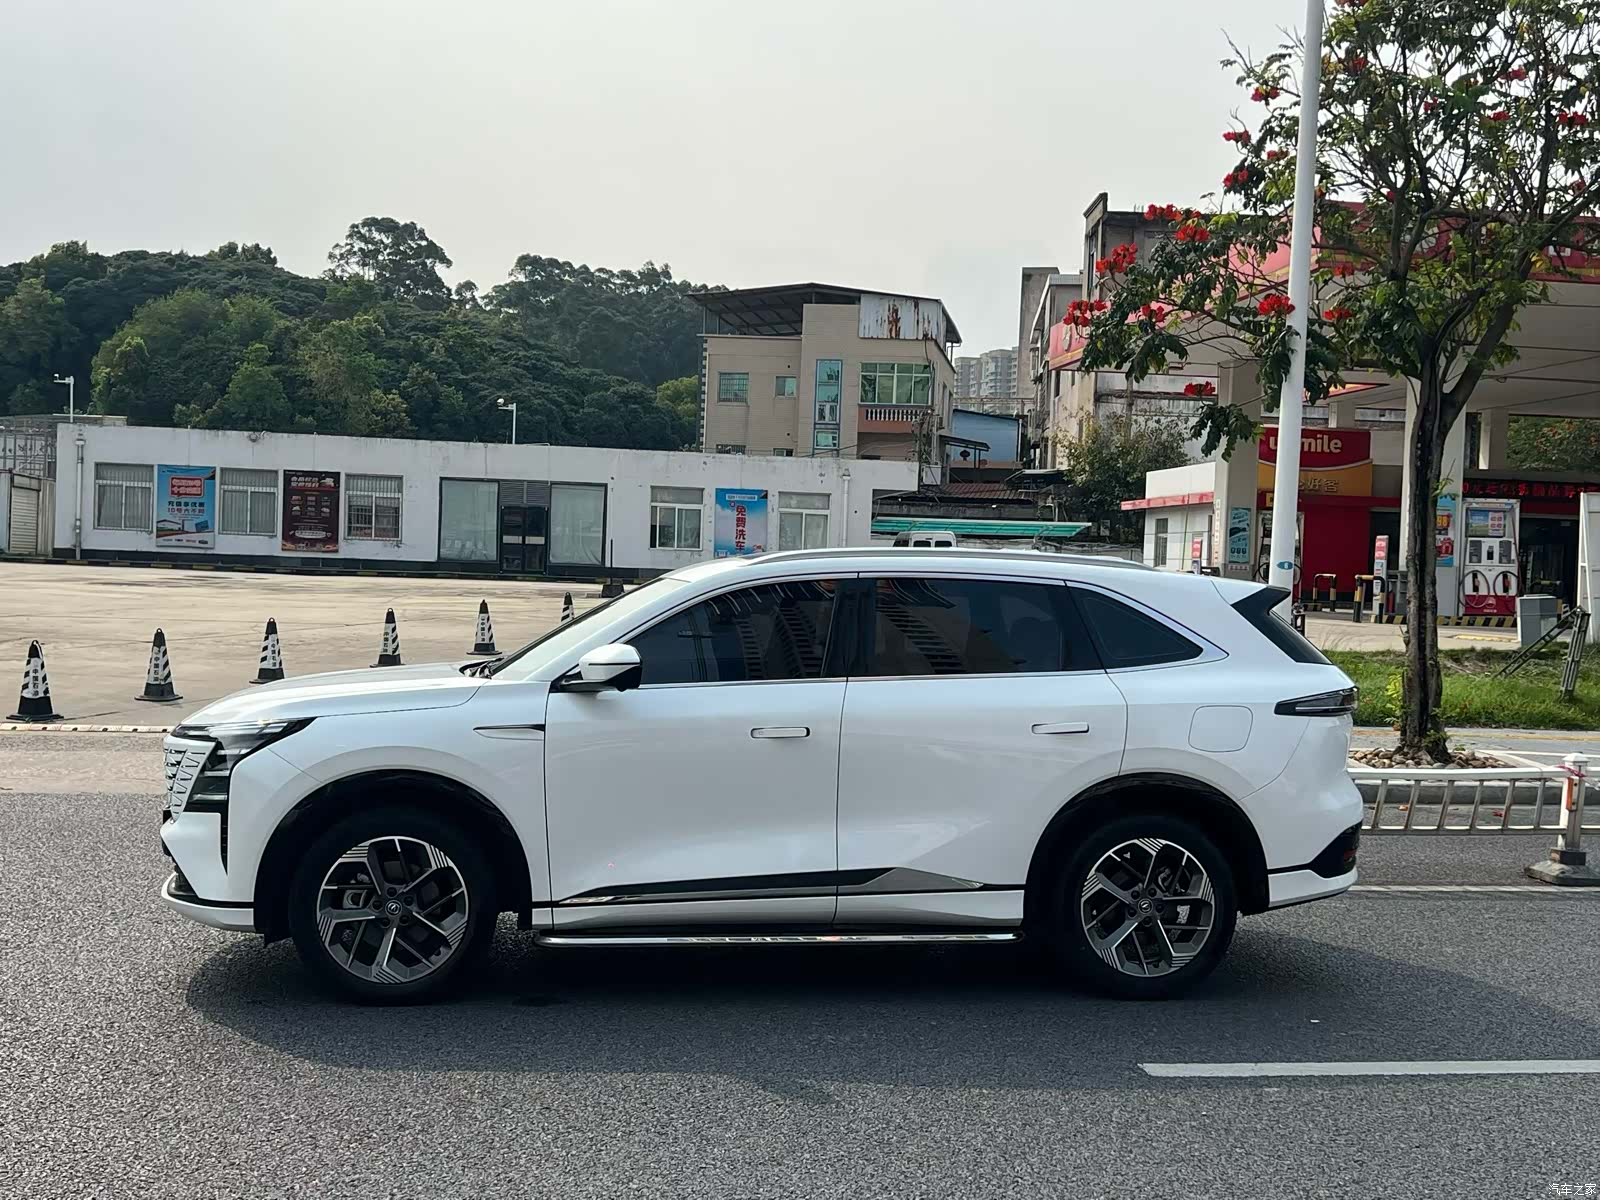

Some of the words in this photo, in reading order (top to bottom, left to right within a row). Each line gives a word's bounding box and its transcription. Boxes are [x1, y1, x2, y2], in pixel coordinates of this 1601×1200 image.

[1269, 434, 1342, 454] umile
[735, 505, 747, 552] 免费洗车
